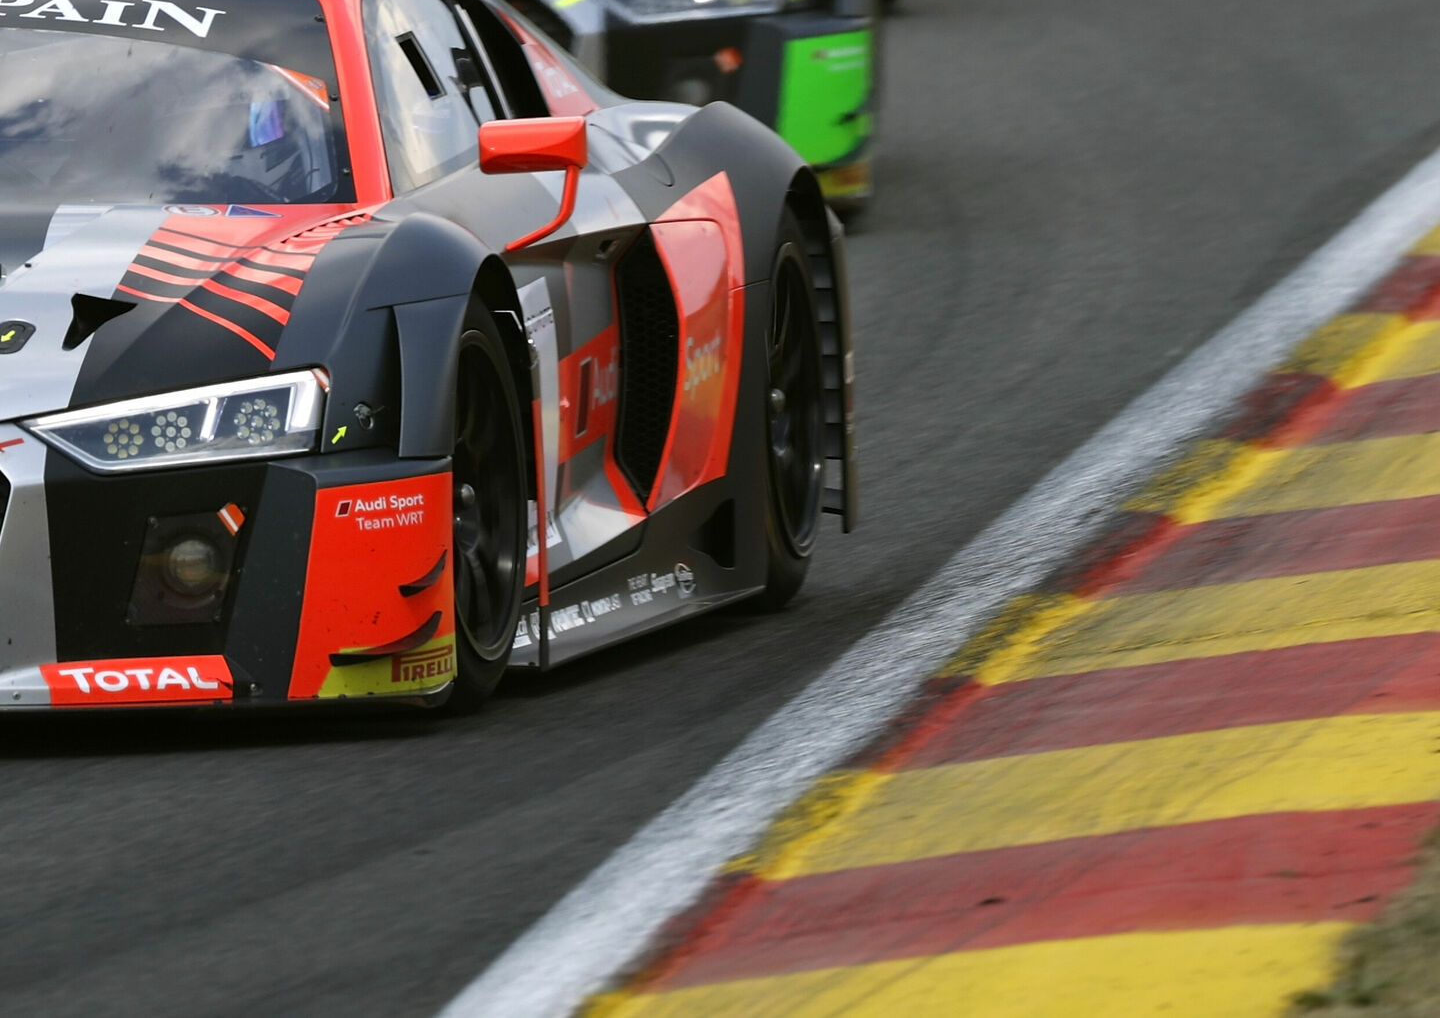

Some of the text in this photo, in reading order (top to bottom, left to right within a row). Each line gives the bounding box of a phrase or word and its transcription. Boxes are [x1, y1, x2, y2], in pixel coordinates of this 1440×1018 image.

[683, 329, 722, 400] Sport
[355, 494, 424, 513] Audi Sport
[356, 511, 424, 530] Team WRT
[392, 644, 453, 682] PIRELLI
[60, 667, 219, 694] TOTAL
